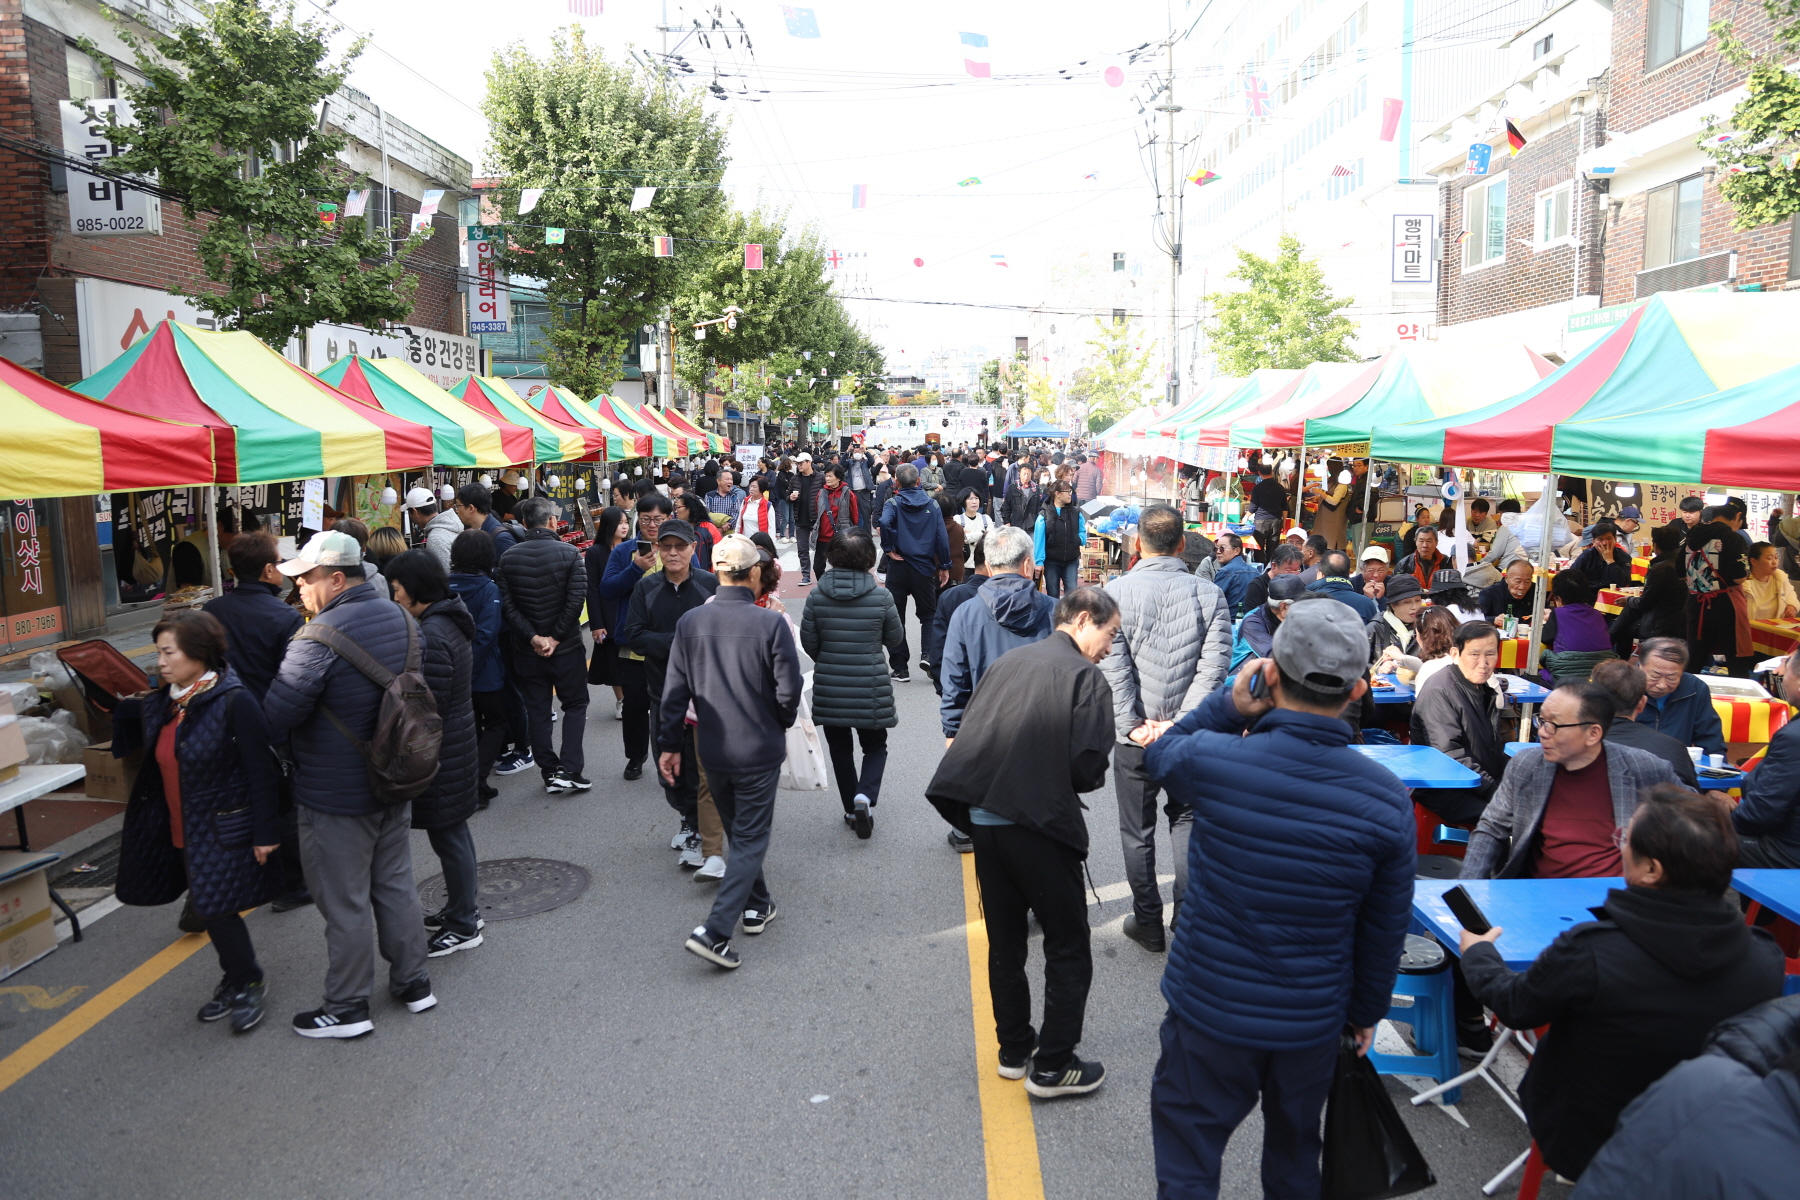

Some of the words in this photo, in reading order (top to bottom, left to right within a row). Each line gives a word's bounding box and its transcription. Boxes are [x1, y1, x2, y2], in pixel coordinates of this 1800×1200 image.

[77, 217, 144, 231] 985-0022
[477, 243, 497, 320] 인테리어
[472, 322, 506, 332] 945-3387
[1397, 324, 1419, 341] 약
[409, 334, 476, 372] 중앙건강원
[1650, 485, 1677, 504] 꼼장어
[1650, 507, 1677, 523] 오돌뼈
[15, 614, 56, 636] 980-7966
